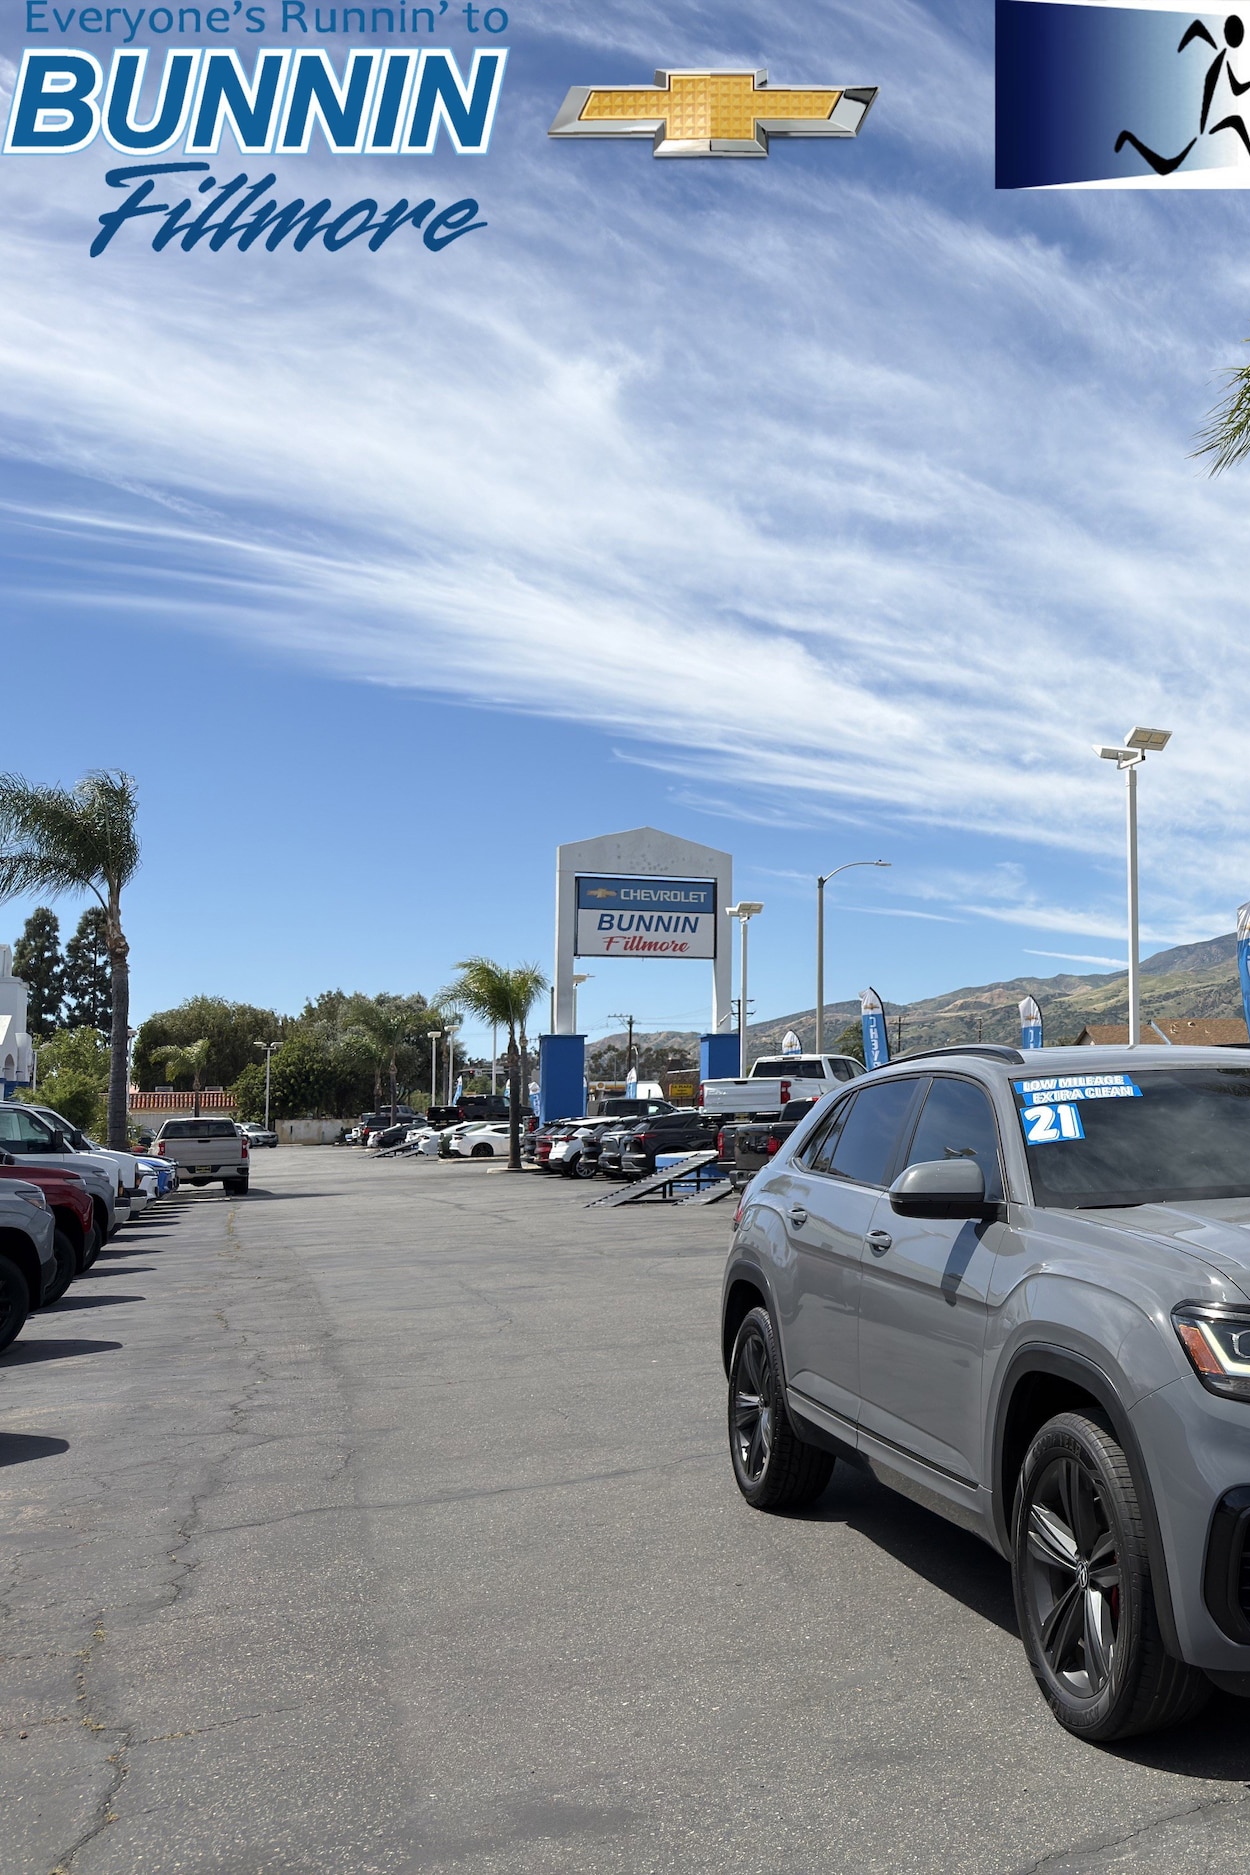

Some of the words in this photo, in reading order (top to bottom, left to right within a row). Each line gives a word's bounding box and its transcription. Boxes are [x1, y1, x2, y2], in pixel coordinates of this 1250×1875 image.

[620, 887, 707, 903] CHEVROLET
[597, 913, 699, 934] BUNNIN
[602, 935, 690, 953] Fillmore
[1023, 1080, 1056, 1093] LOW
[1058, 1075, 1125, 1089] MILEAGE
[1032, 1088, 1085, 1104] EXTRA
[1085, 1086, 1134, 1099] CLEAN
[1024, 1104, 1080, 1142] 21
